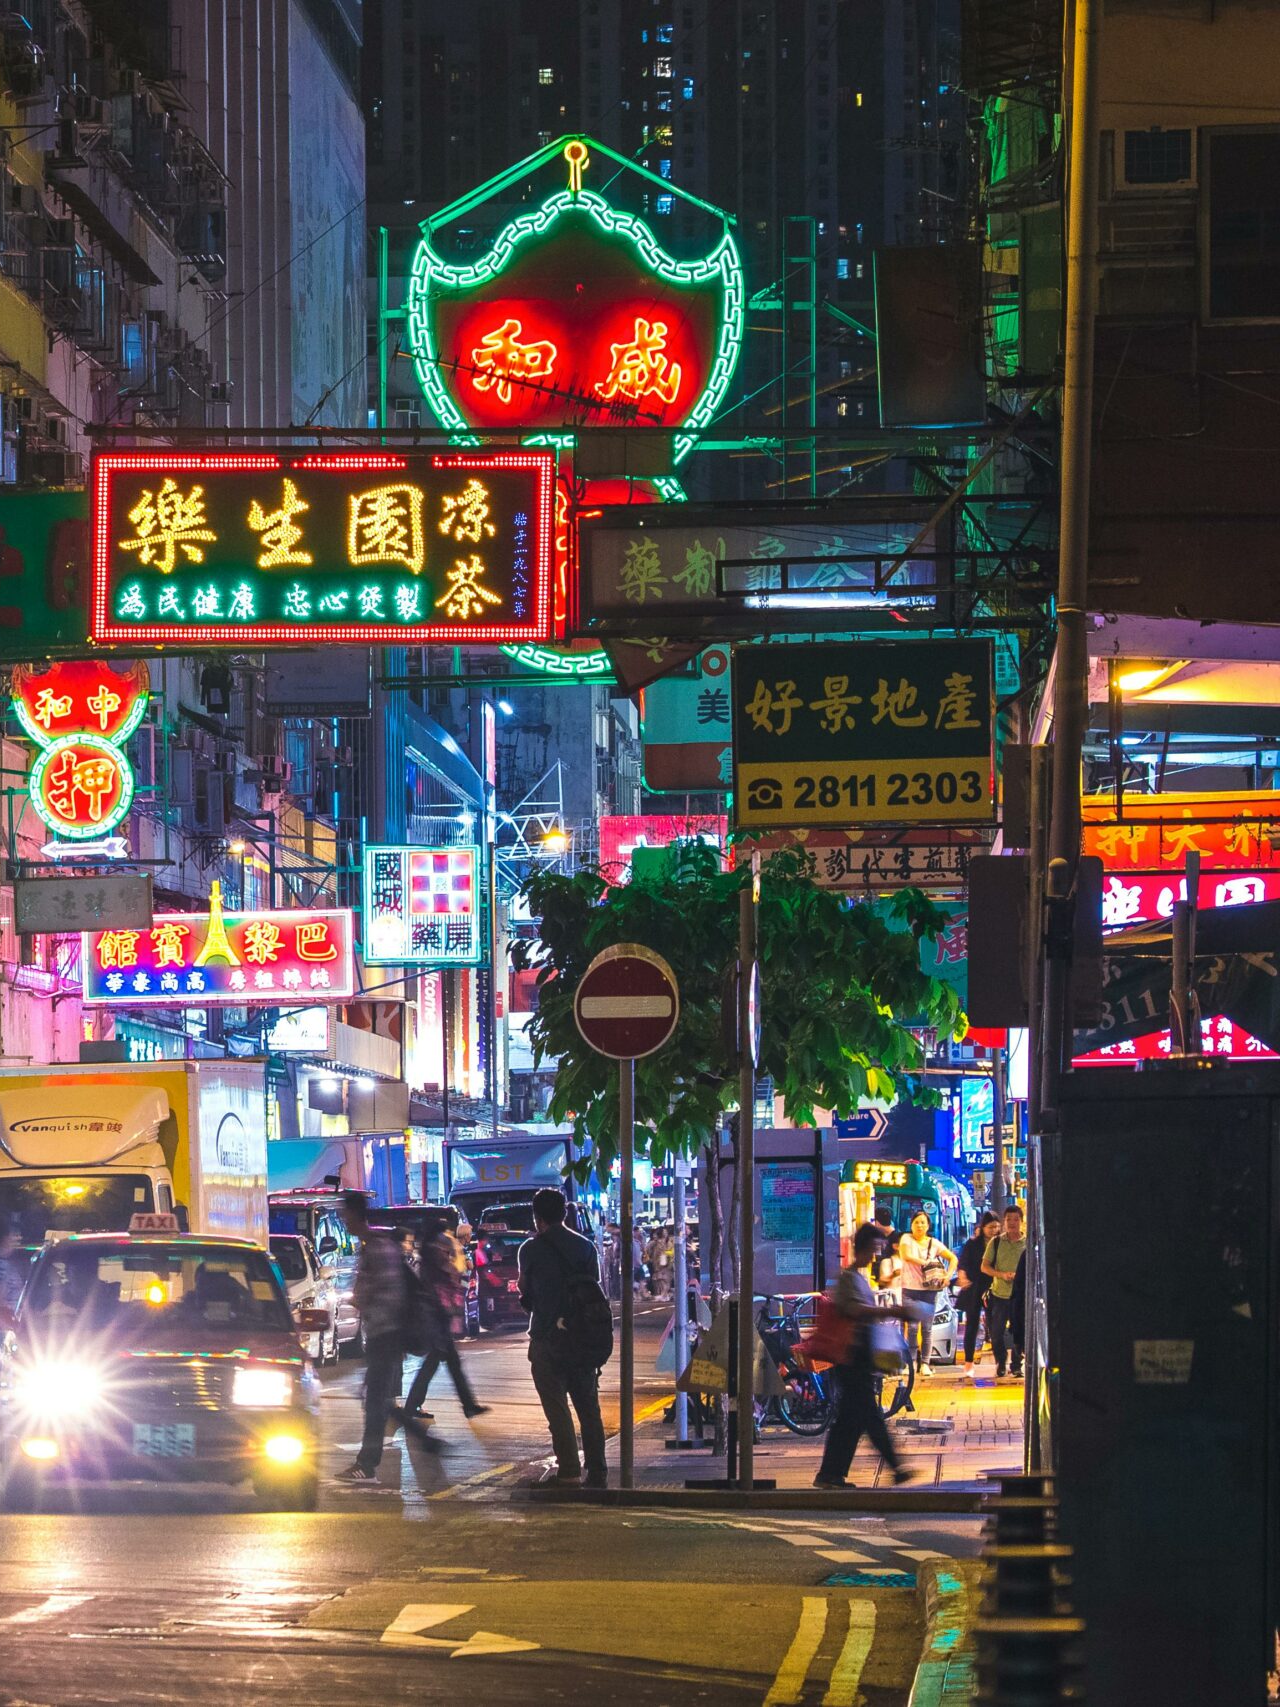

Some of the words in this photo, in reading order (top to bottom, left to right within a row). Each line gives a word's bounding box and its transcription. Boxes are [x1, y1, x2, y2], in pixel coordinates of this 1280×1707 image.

[118, 477, 424, 574] 樂生園
[744, 671, 982, 737] 好景地產
[47, 749, 116, 821] 押
[793, 774, 877, 809] 2811
[886, 769, 983, 806] 2303
[96, 921, 338, 970] 巴黎賓館
[21, 1121, 88, 1134] Vanquish
[480, 1164, 525, 1183] LST
